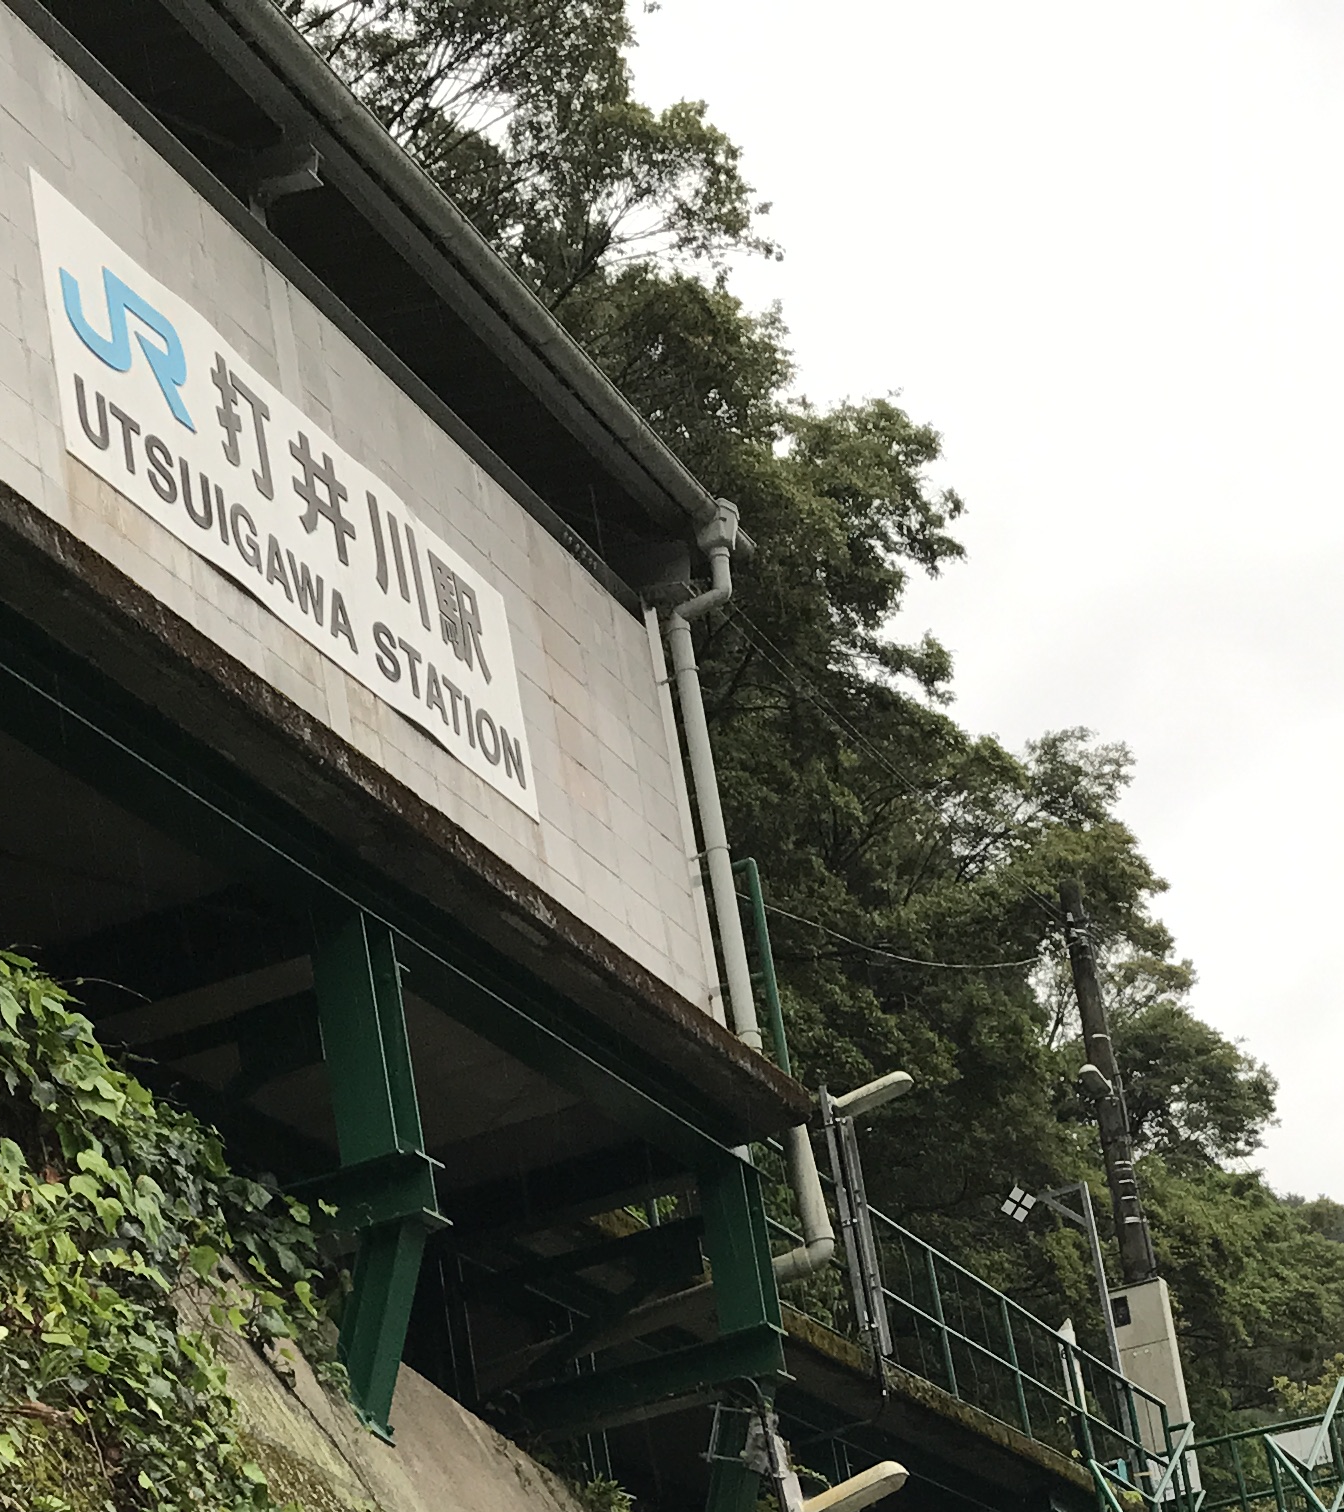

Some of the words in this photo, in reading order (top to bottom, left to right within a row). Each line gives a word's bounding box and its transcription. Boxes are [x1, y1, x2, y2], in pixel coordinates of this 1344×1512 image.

[59, 266, 195, 433] JR
[74, 373, 359, 655] UTSUIGAWA
[373, 621, 526, 790] STATION
[211, 351, 493, 685] 打井川駅
